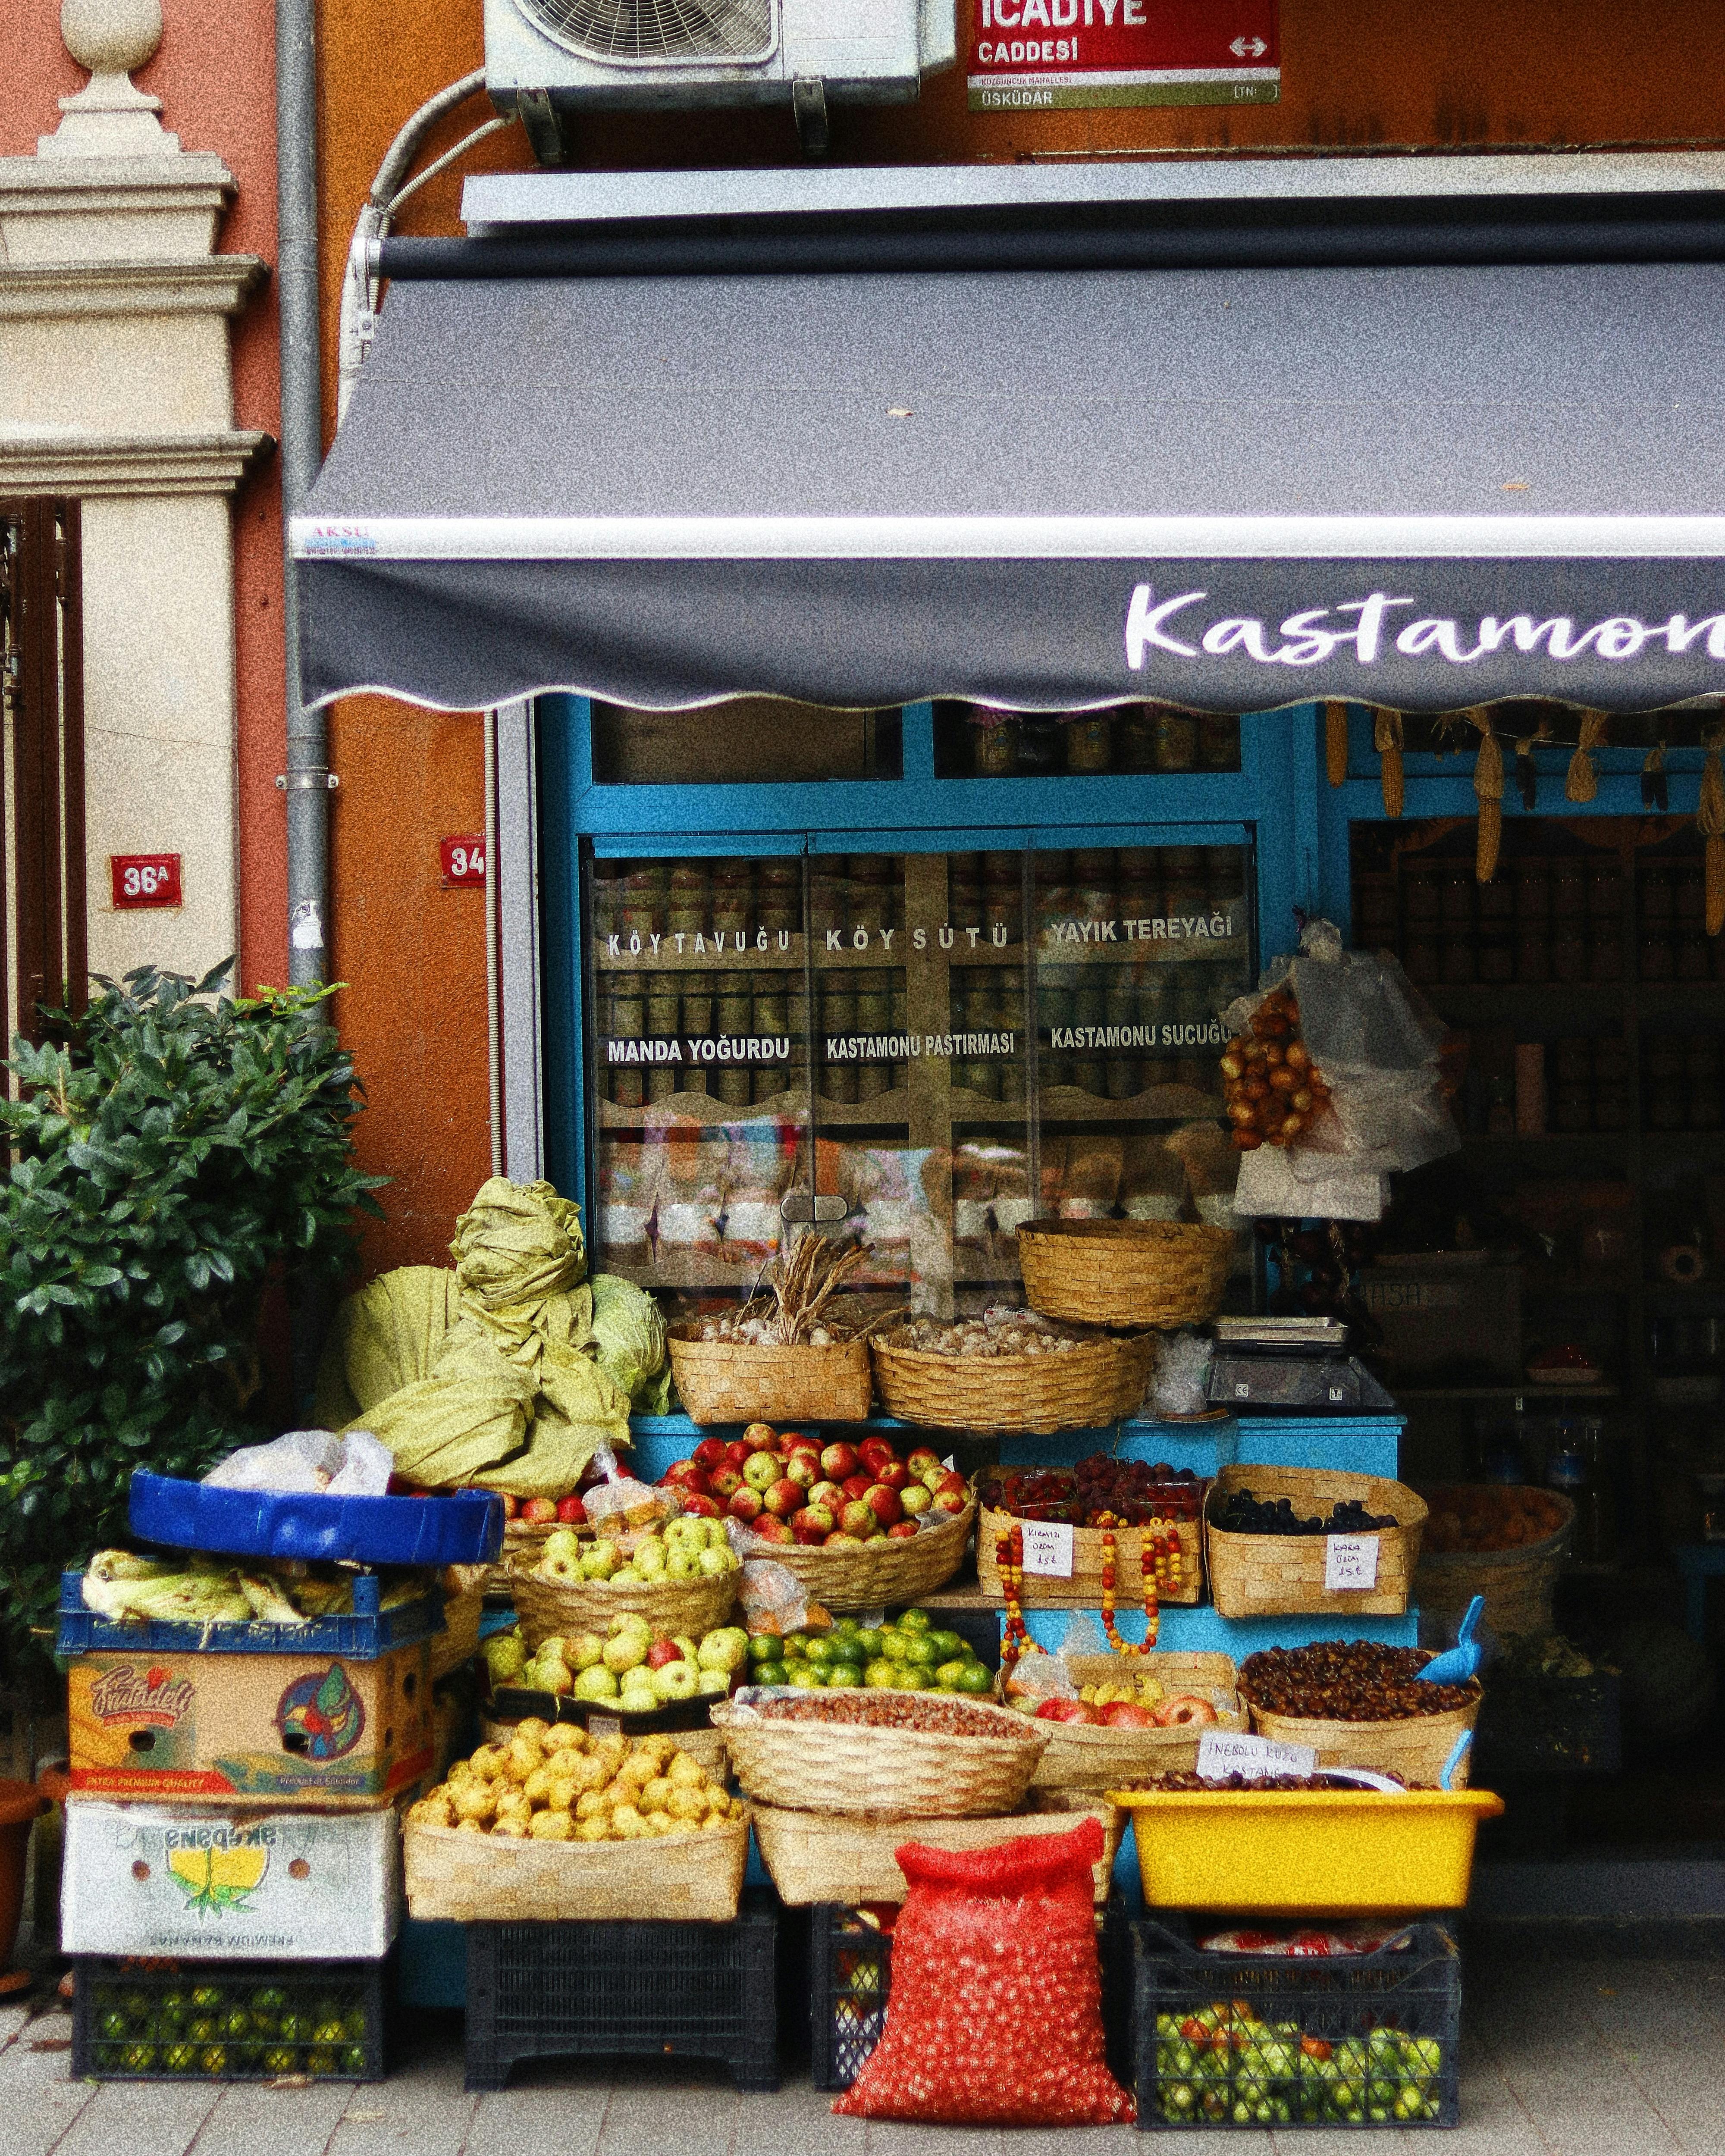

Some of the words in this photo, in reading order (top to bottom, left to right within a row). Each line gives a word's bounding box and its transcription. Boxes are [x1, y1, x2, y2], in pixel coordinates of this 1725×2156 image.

[978, 37, 1078, 62] CADDESİ
[981, 77, 1027, 85] KUZGUNCUK
[1029, 75, 1072, 84] MAHALLESİ
[982, 90, 1053, 106] ÜSKÜDAR
[312, 526, 370, 537] AKSU
[451, 847, 485, 876] 34
[123, 865, 169, 896] 36A
[826, 924, 894, 950] KÖY
[912, 922, 1007, 950] SÜTÜ
[1051, 920, 1117, 943] YAYIK
[1123, 911, 1232, 940] TEREYAĞI
[827, 1035, 920, 1059] KASTAMONU
[925, 1033, 1015, 1056] PASTIRMASI
[1051, 1025, 1156, 1048] KASTAMONU
[1161, 1018, 1232, 1046] SUCUĞU
[608, 1039, 682, 1062] MANDA
[687, 1034, 790, 1062] YOĞURDU
